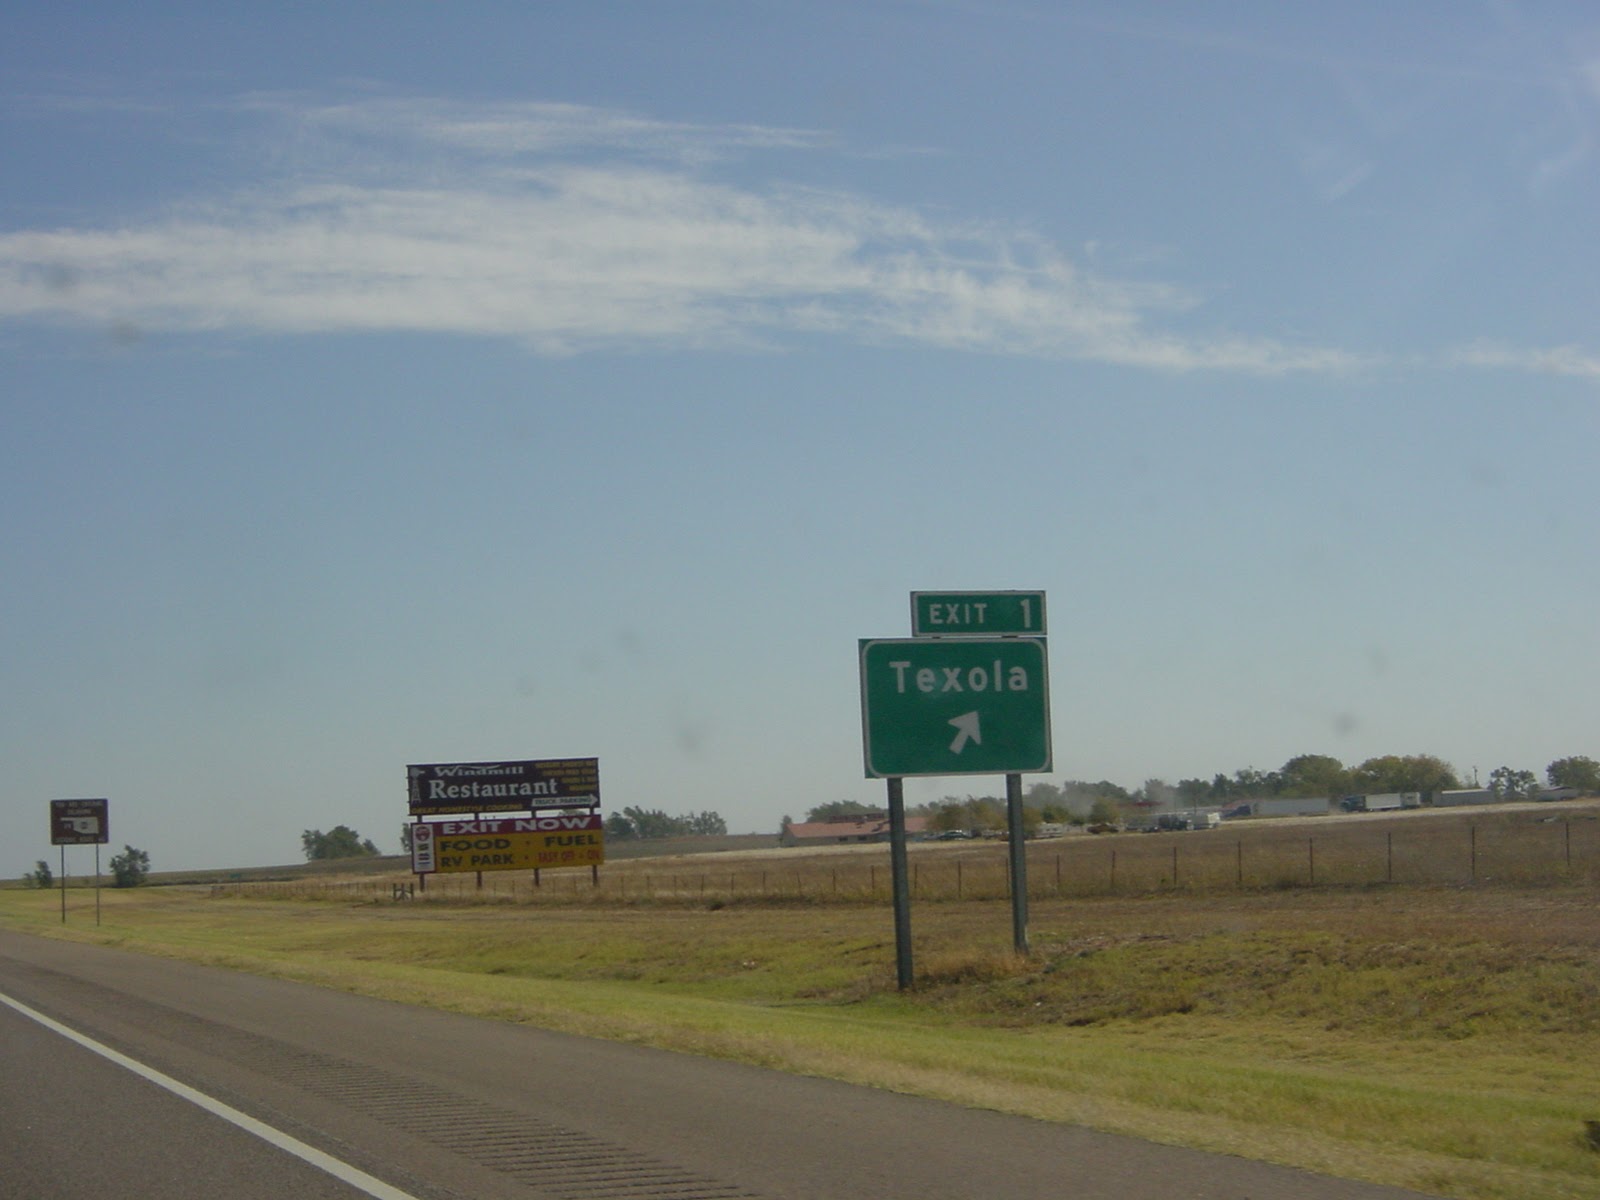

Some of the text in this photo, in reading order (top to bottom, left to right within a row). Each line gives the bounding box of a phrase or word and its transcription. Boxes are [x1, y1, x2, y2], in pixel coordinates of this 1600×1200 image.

[929, 599, 1032, 629] EXIT 1
[889, 660, 1028, 693] Texola
[435, 764, 524, 777] Windmill
[429, 779, 557, 799] Restaurant
[443, 822, 502, 834] EXIT
[515, 817, 592, 831] NOW
[441, 839, 511, 851] FOOD
[545, 835, 598, 847] FUEL
[442, 857, 462, 867] RV
[471, 854, 513, 865] PARK
